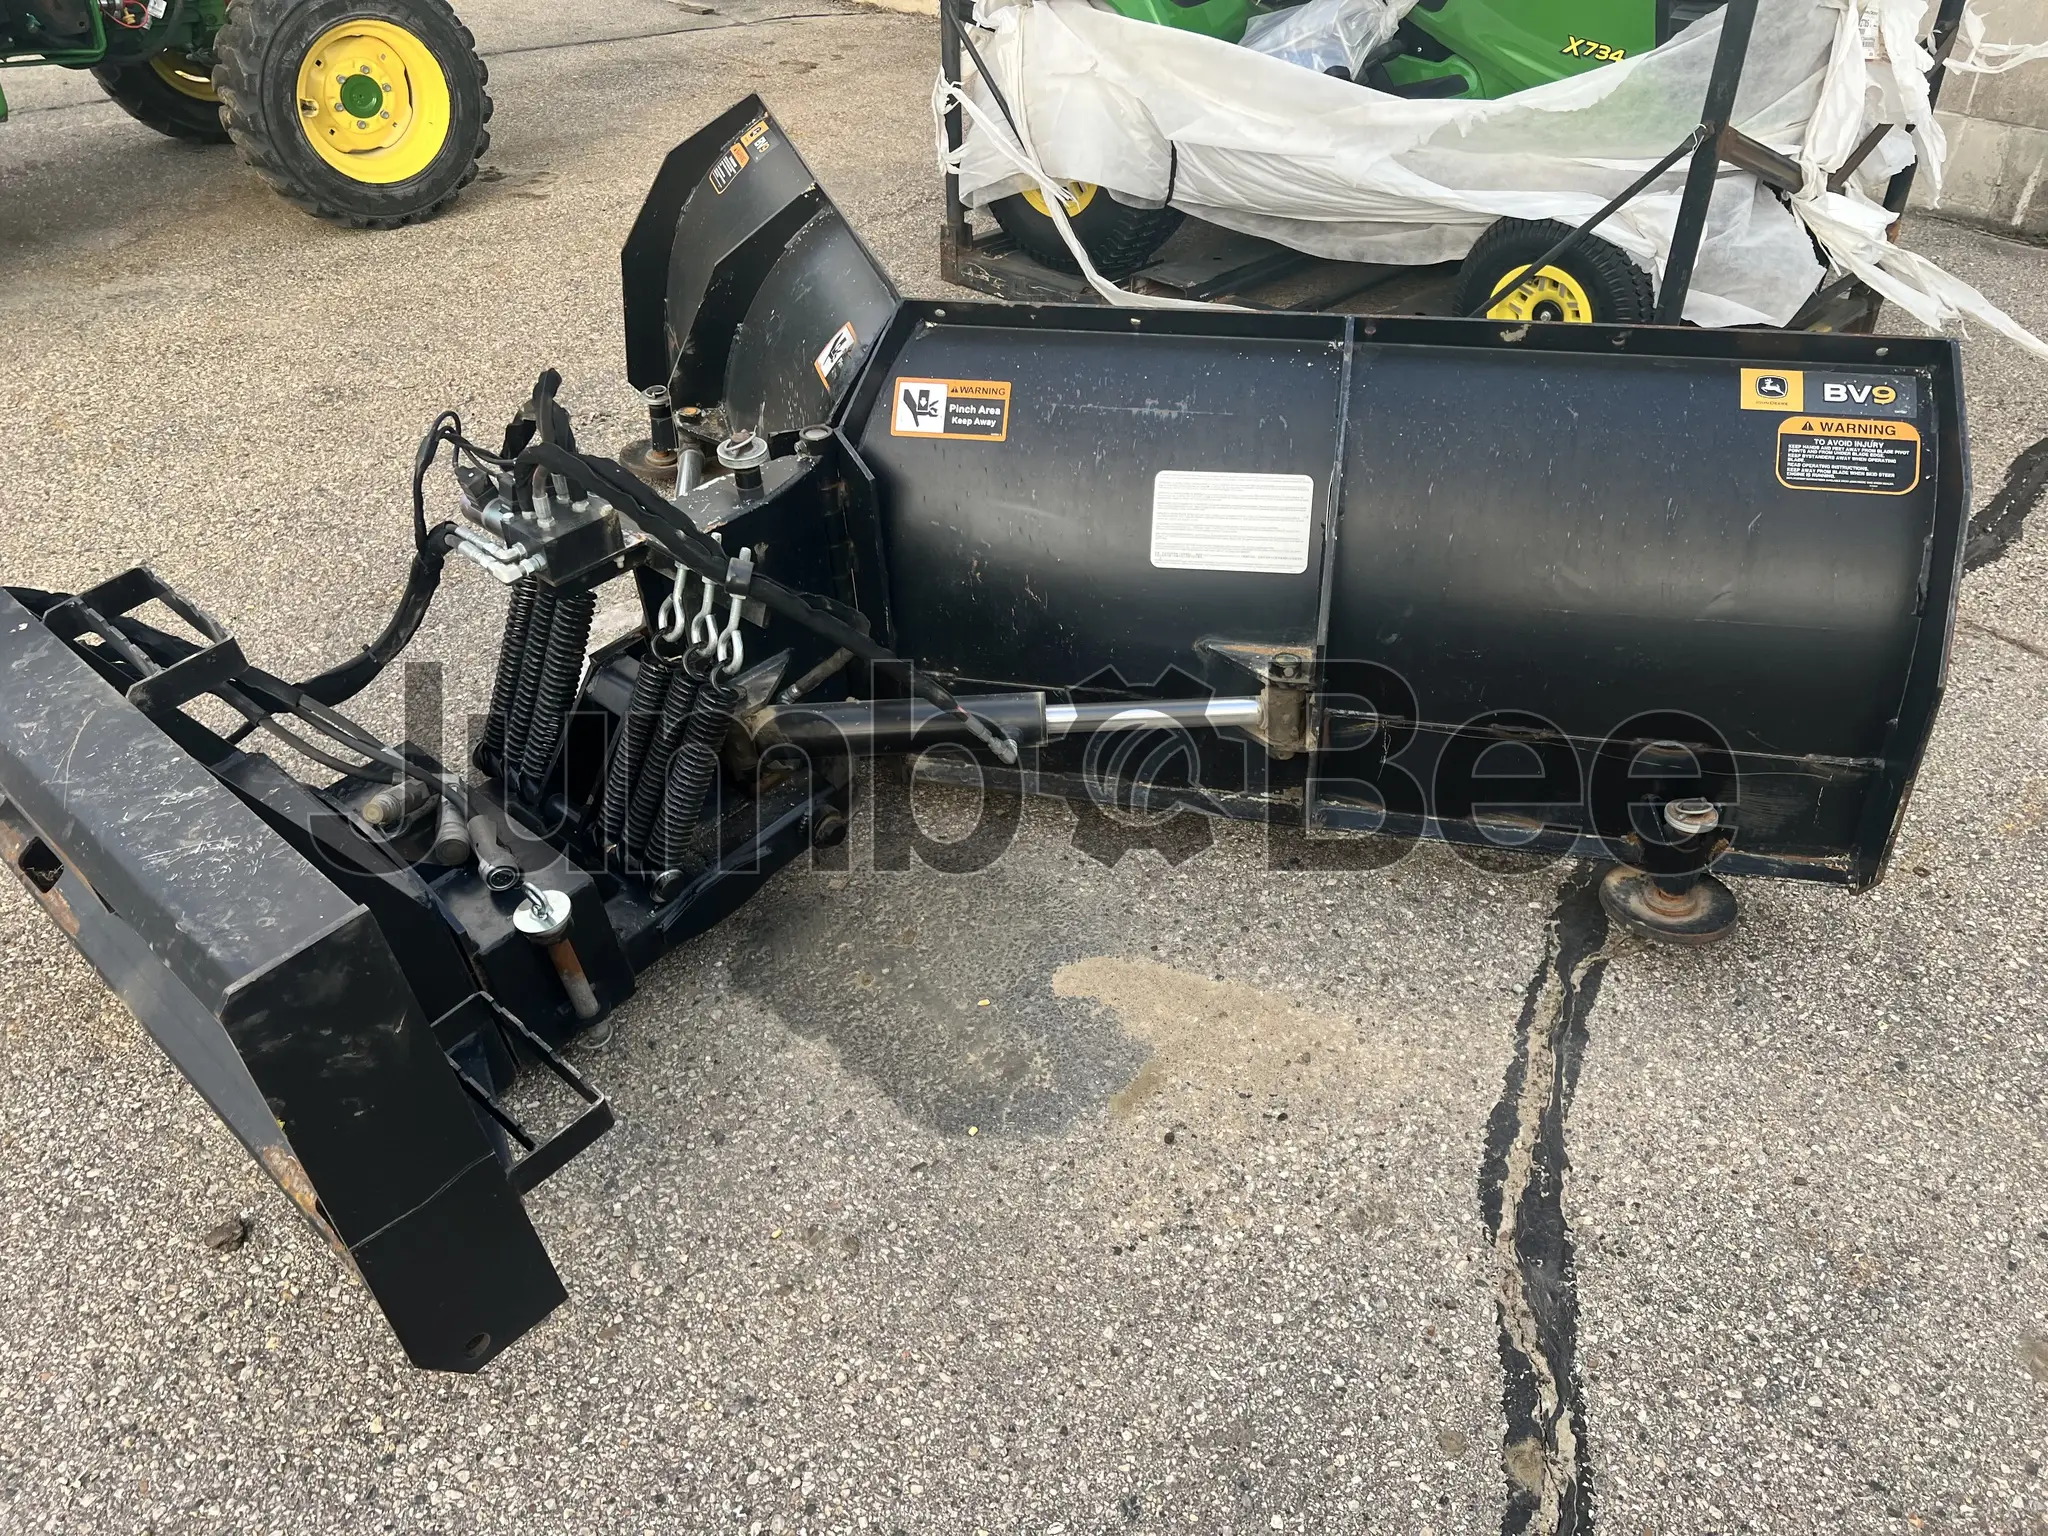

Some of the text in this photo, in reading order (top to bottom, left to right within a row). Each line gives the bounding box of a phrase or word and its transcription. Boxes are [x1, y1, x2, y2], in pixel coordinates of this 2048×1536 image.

[1560, 35, 1626, 63] X734
[960, 386, 1006, 396] WARNING
[1823, 382, 1897, 405] BV9
[949, 404, 1000, 415] Pinch Area
[952, 416, 996, 428] Keep Away
[1820, 422, 1897, 436] WARNING
